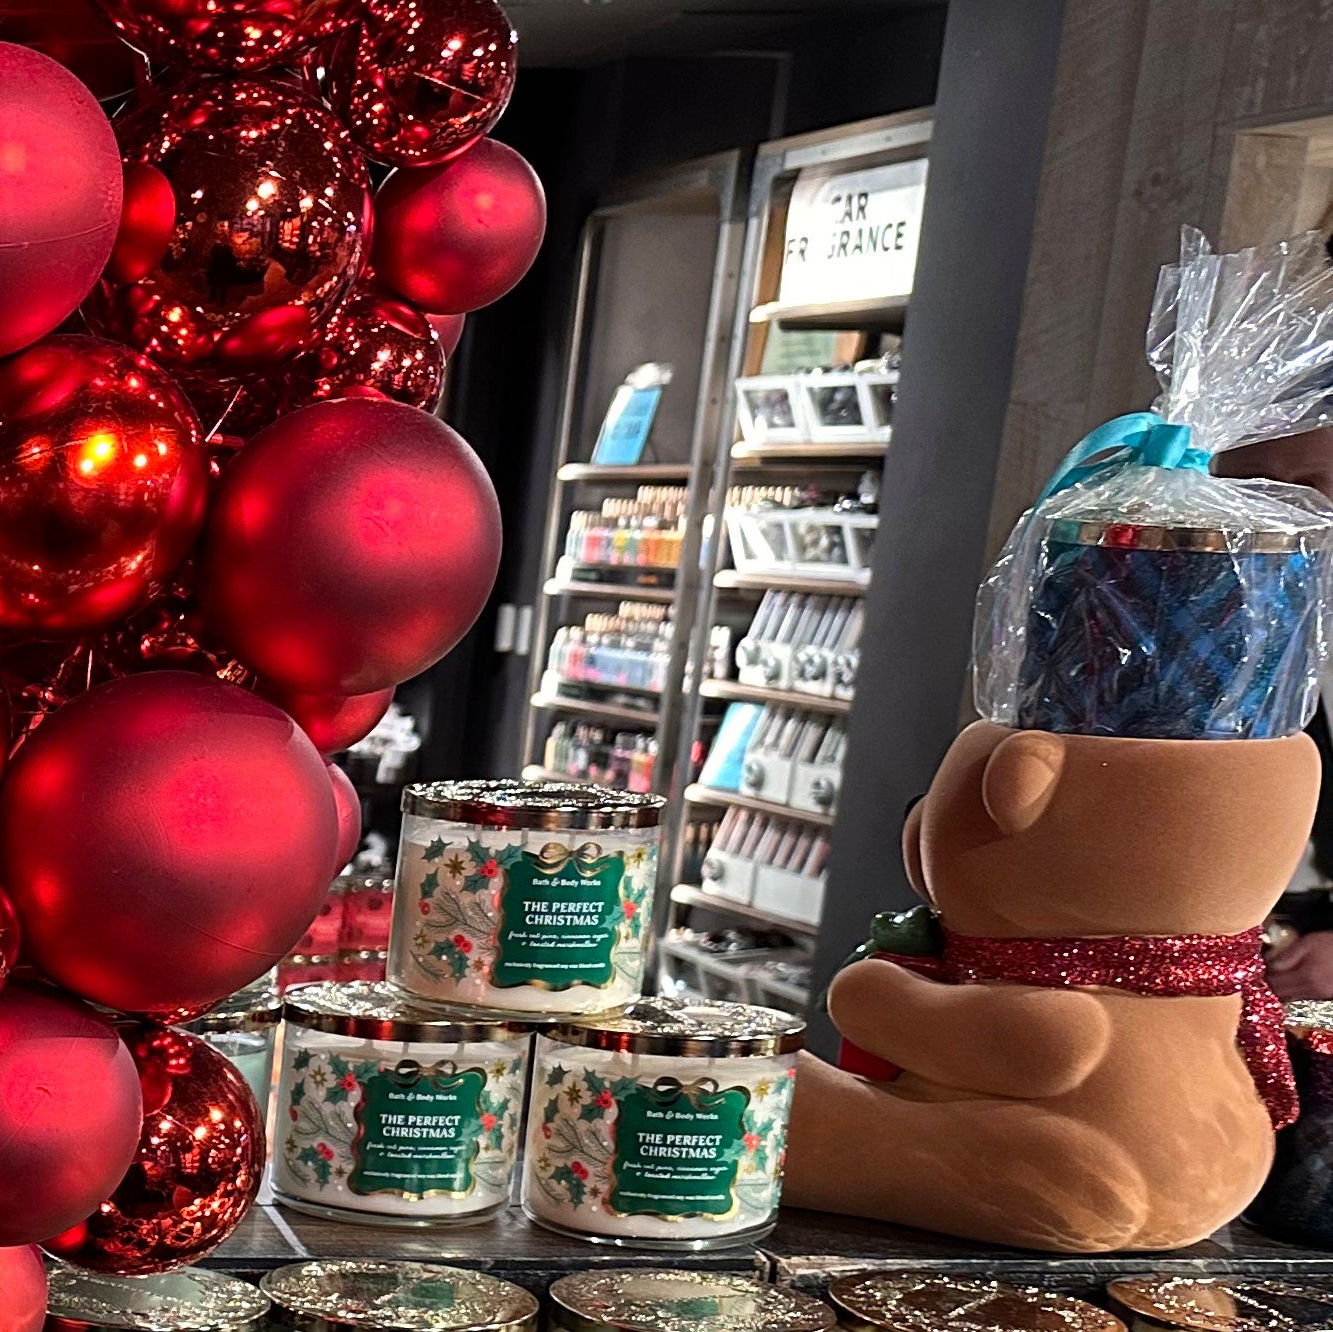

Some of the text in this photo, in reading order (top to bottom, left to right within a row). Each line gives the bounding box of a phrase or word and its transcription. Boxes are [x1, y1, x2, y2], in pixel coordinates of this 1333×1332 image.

[785, 221, 906, 263] FRRANCE
[523, 901, 604, 913] THE PERFECT
[525, 914, 600, 926] CHRISTMAS
[380, 1114, 461, 1126] THE PERFECT
[383, 1127, 456, 1138] CHRISTMAS
[637, 1132, 723, 1146] THE PERFECT
[639, 1146, 717, 1159] CHRISTMAS
